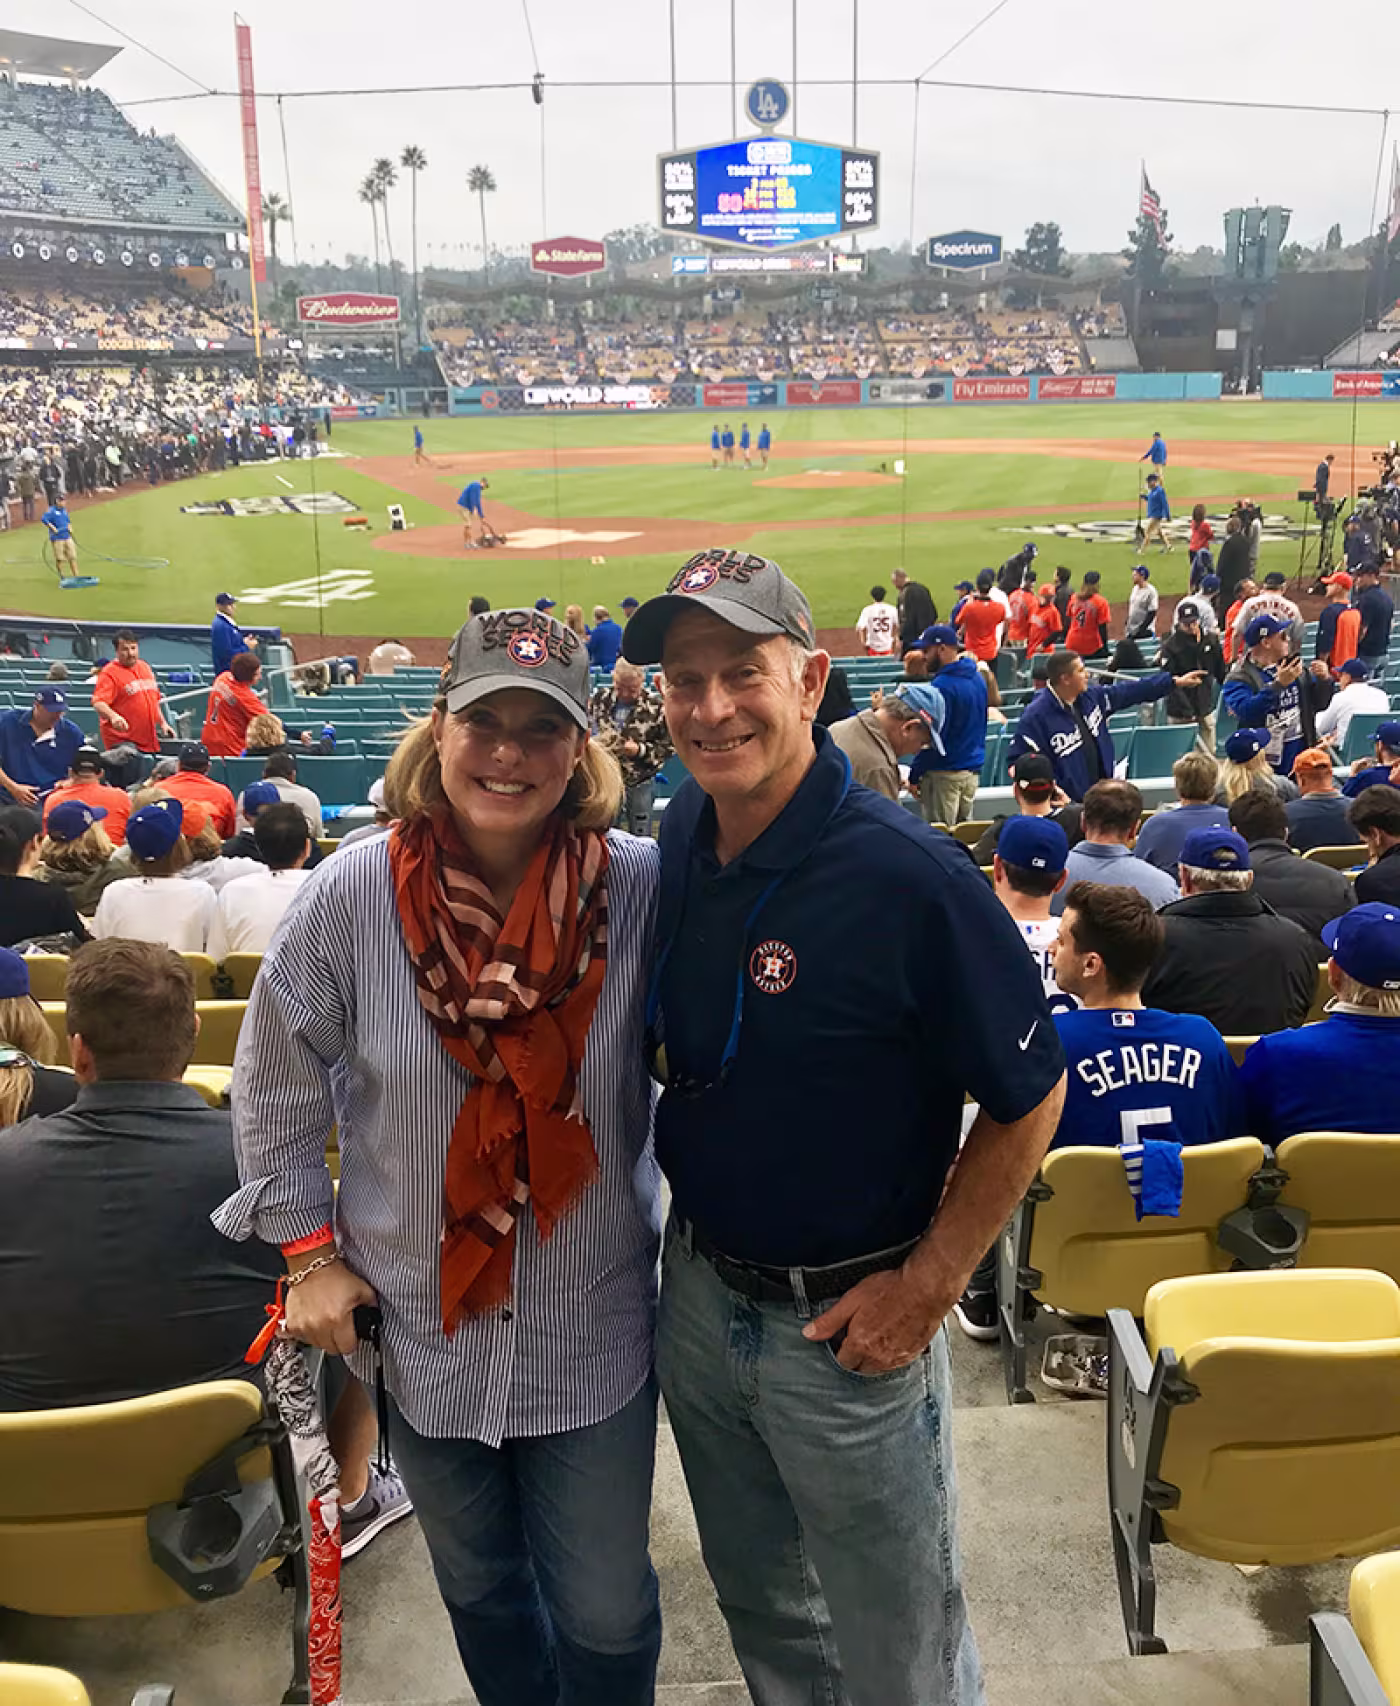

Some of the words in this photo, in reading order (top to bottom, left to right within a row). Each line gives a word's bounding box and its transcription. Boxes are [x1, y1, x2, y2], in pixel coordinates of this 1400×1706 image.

[757, 86, 779, 119] LA
[934, 242, 992, 259] Spectrum
[302, 300, 397, 318] Budweiser
[955, 383, 975, 397] Fly
[976, 382, 1028, 395] Emirates
[478, 611, 581, 651] WORLD
[873, 616, 890, 632] 35
[1076, 1042, 1202, 1098] SEAGER
